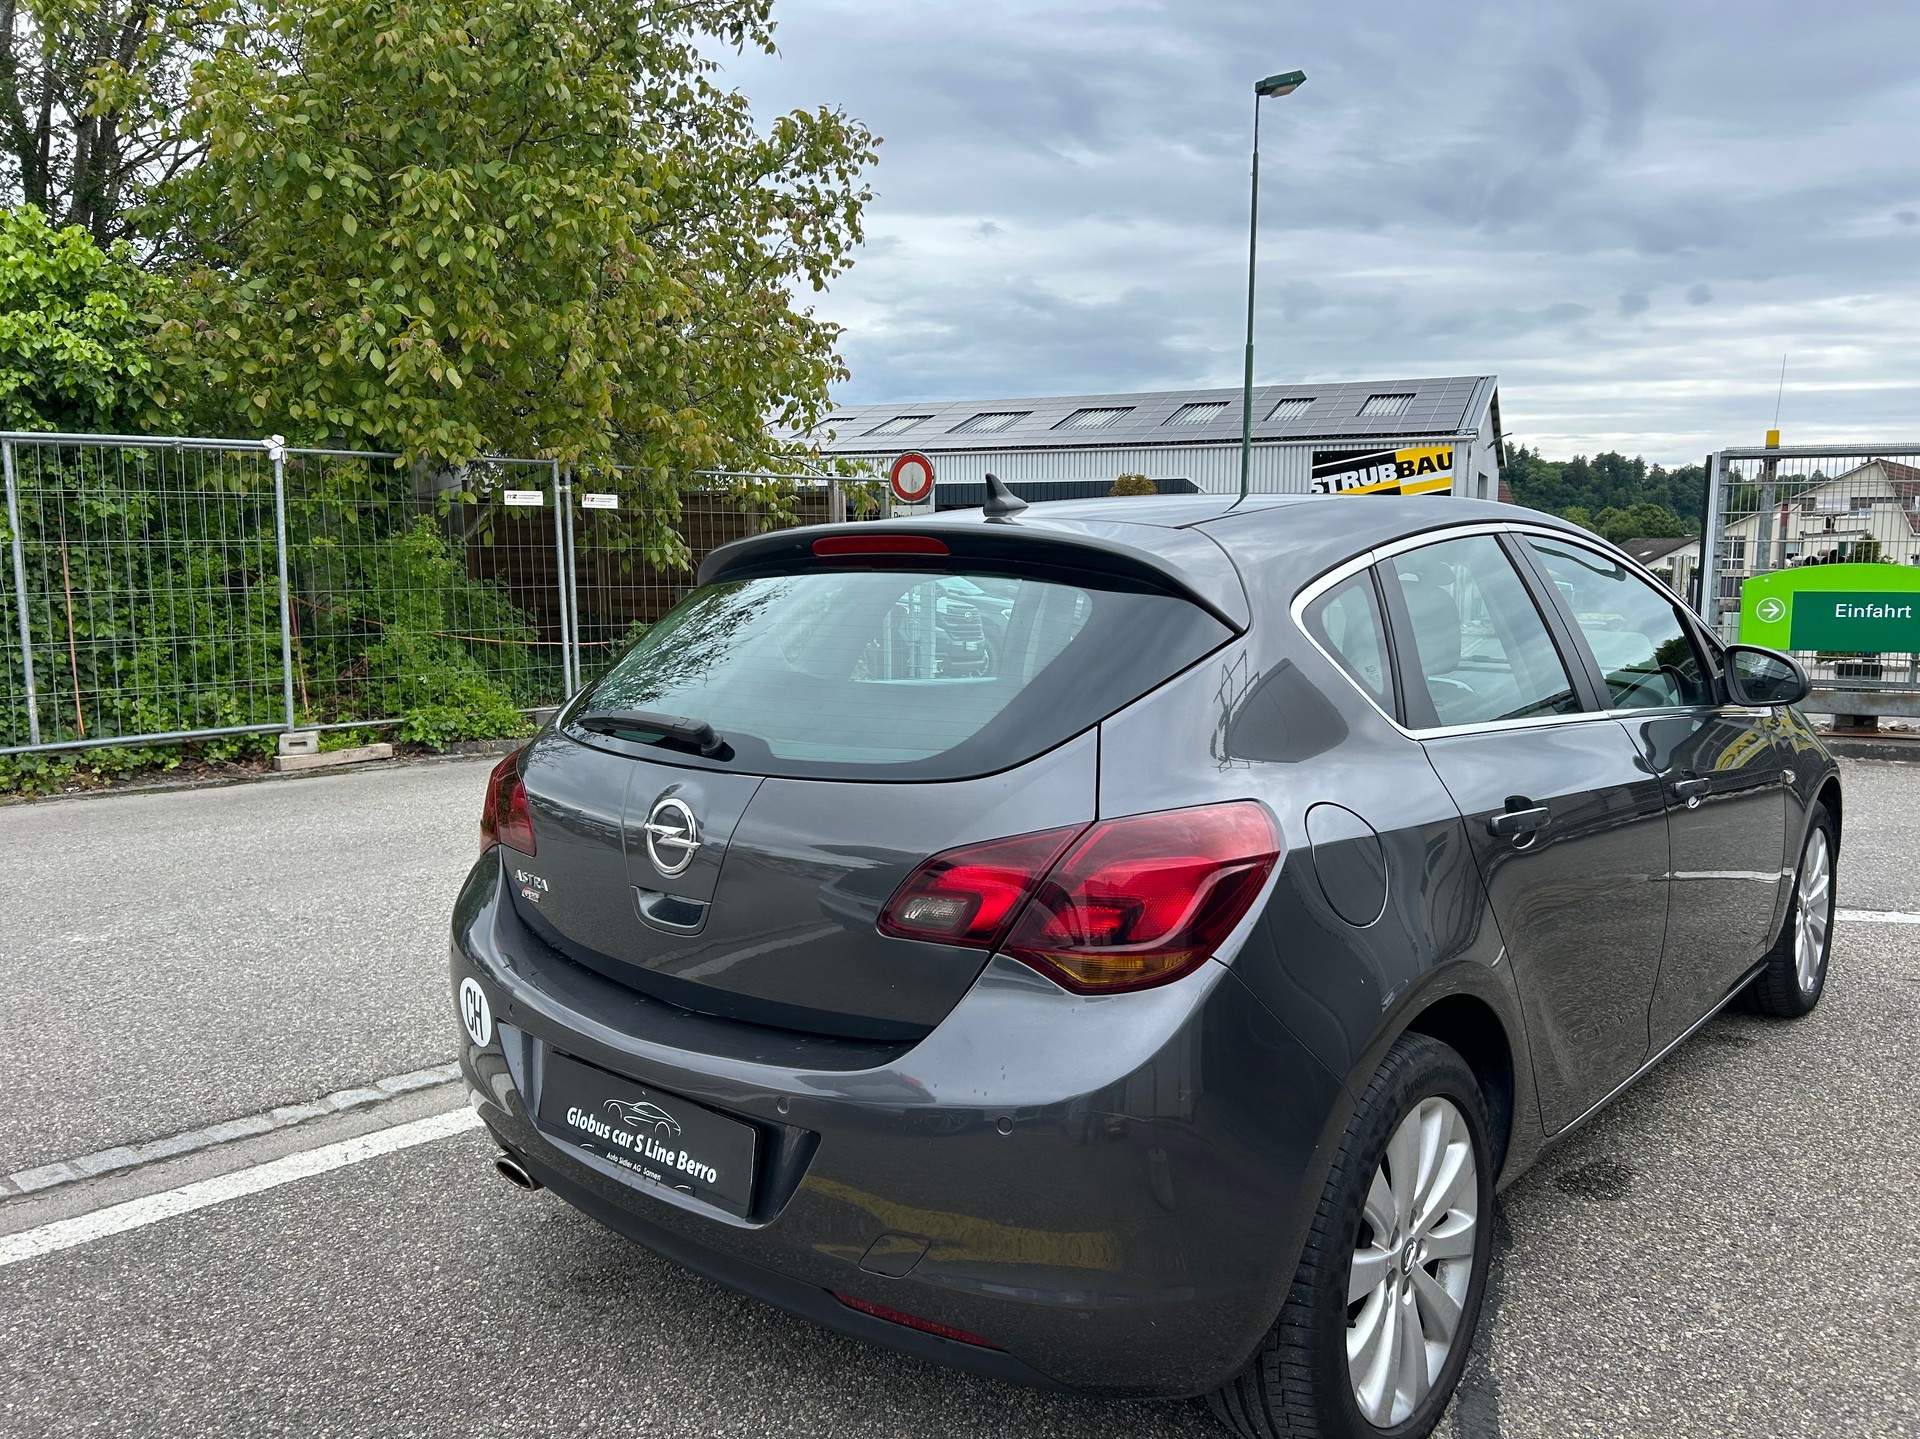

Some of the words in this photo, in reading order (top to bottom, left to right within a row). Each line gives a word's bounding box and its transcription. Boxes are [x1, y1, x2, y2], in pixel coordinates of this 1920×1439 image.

[1835, 603, 1912, 619] Einfahrt
[515, 869, 549, 892] ASTRA
[465, 986, 484, 1041] CH
[566, 1106, 611, 1139] Globus
[611, 1130, 634, 1150] car
[634, 1134, 644, 1153] S
[644, 1137, 675, 1167] Line
[676, 1150, 717, 1184] Berro
[606, 1152, 618, 1162] Auto
[632, 1163, 642, 1172] AG
